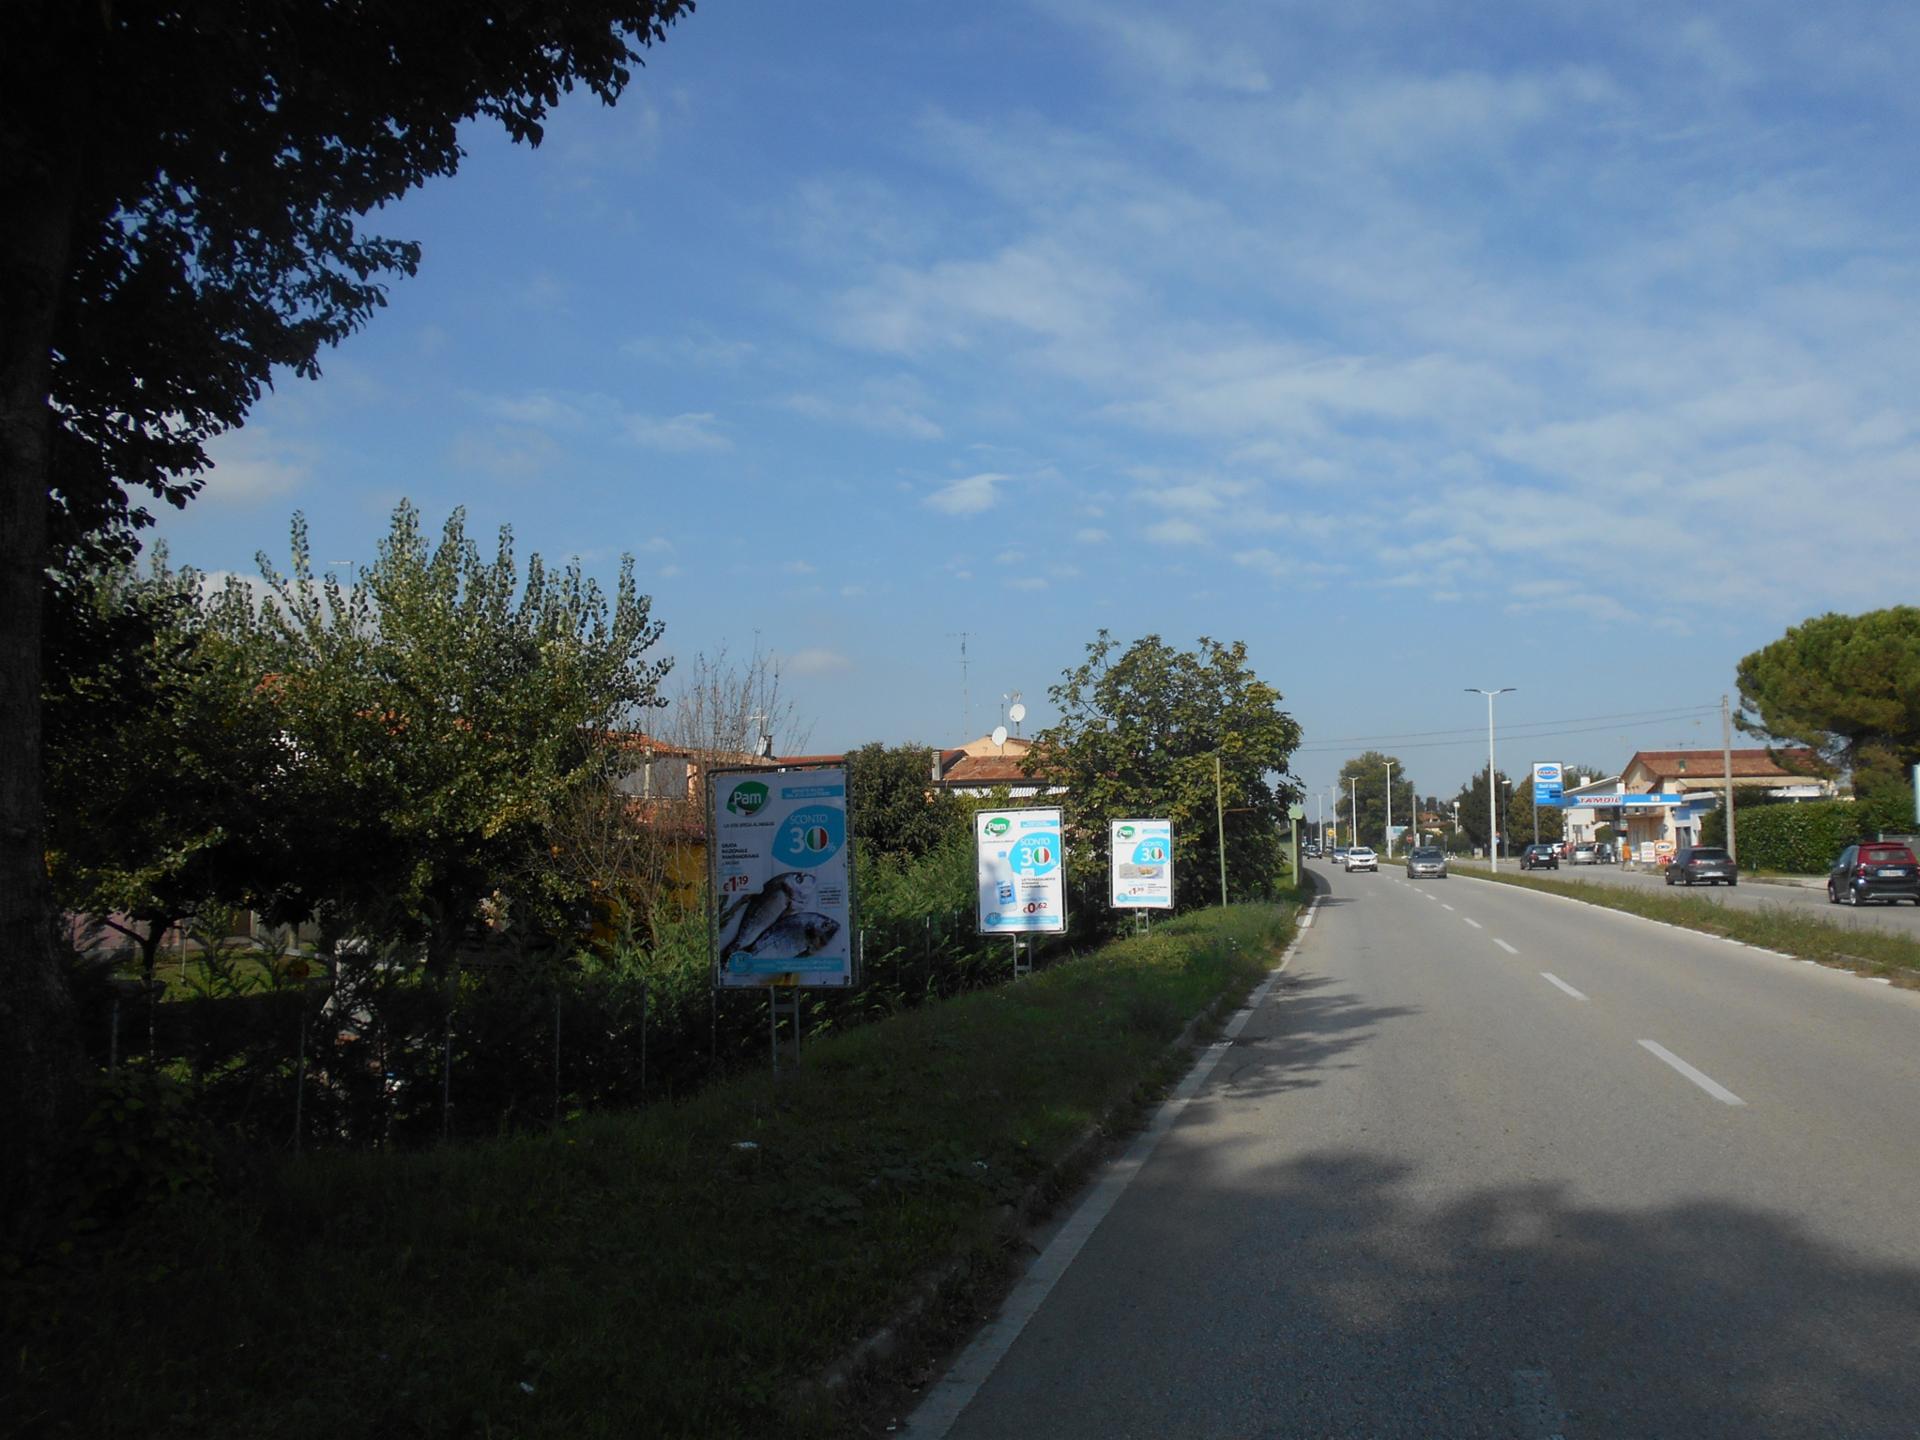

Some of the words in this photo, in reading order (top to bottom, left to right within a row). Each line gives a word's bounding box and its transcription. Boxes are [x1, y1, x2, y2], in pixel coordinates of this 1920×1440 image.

[733, 791, 762, 805] Pam
[1580, 796, 1621, 804] TAMOIL
[790, 814, 828, 824] SCONTO
